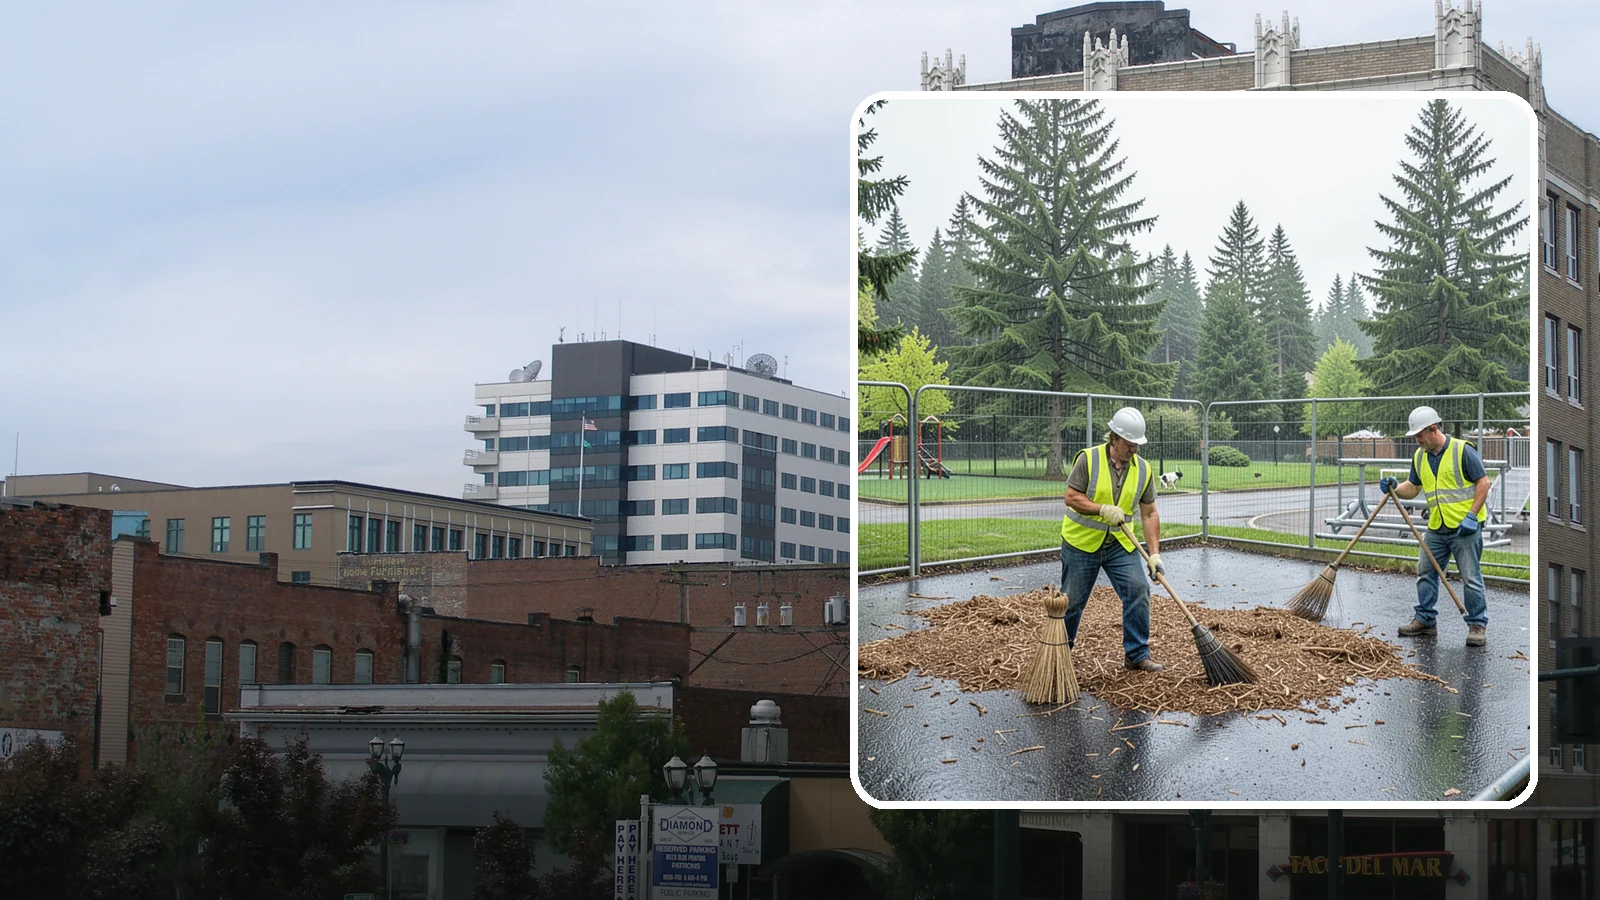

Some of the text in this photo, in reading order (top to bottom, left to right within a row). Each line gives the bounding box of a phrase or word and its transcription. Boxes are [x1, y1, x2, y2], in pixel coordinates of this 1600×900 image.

[343, 568, 368, 577] Home
[660, 818, 713, 832] DIAMOND
[1022, 815, 1070, 828] BUILDING
[689, 846, 716, 854] PARKING
[616, 824, 625, 893] PAY HERE
[628, 824, 637, 893] PAY HERE
[1290, 855, 1443, 877] TAC DEL MAR
[660, 888, 710, 898] PUBLIC PARKING
